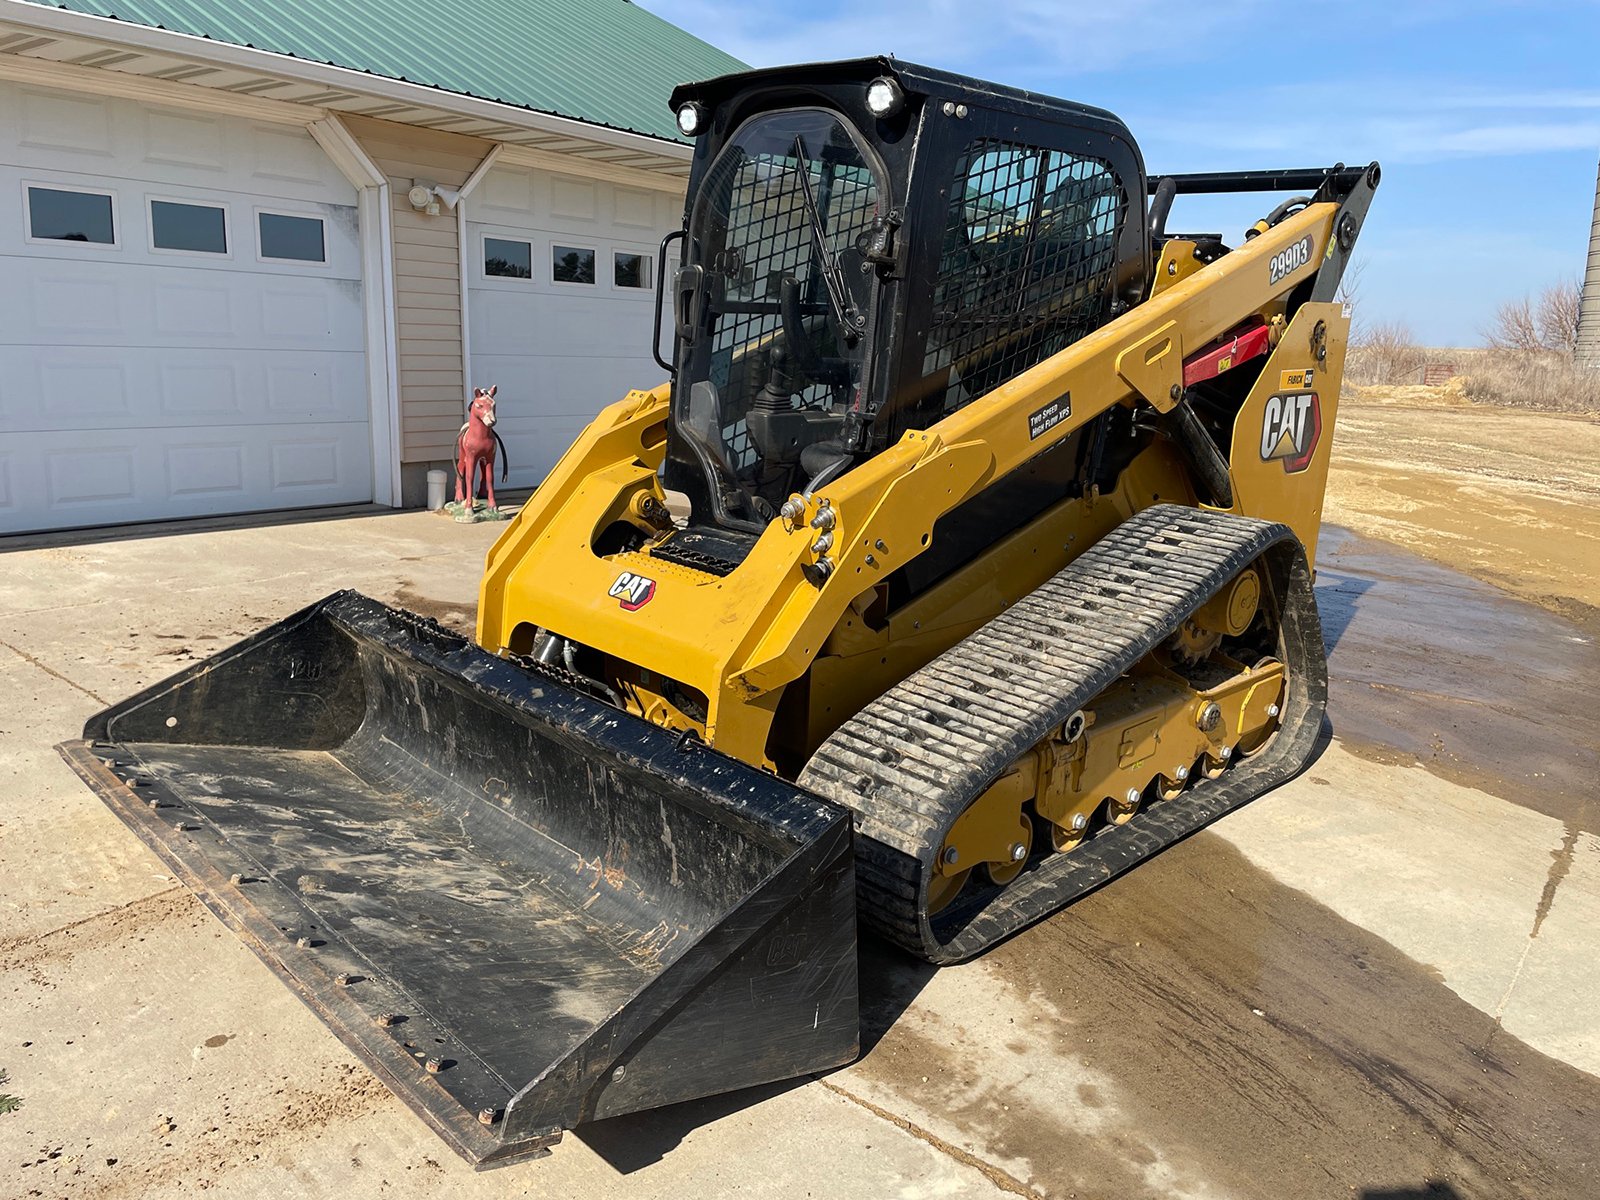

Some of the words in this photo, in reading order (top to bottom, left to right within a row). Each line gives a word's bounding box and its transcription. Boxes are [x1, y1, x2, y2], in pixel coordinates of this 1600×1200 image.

[1270, 238, 1308, 285] 299D3
[1261, 395, 1312, 459] CAT
[609, 571, 652, 603] CAT
